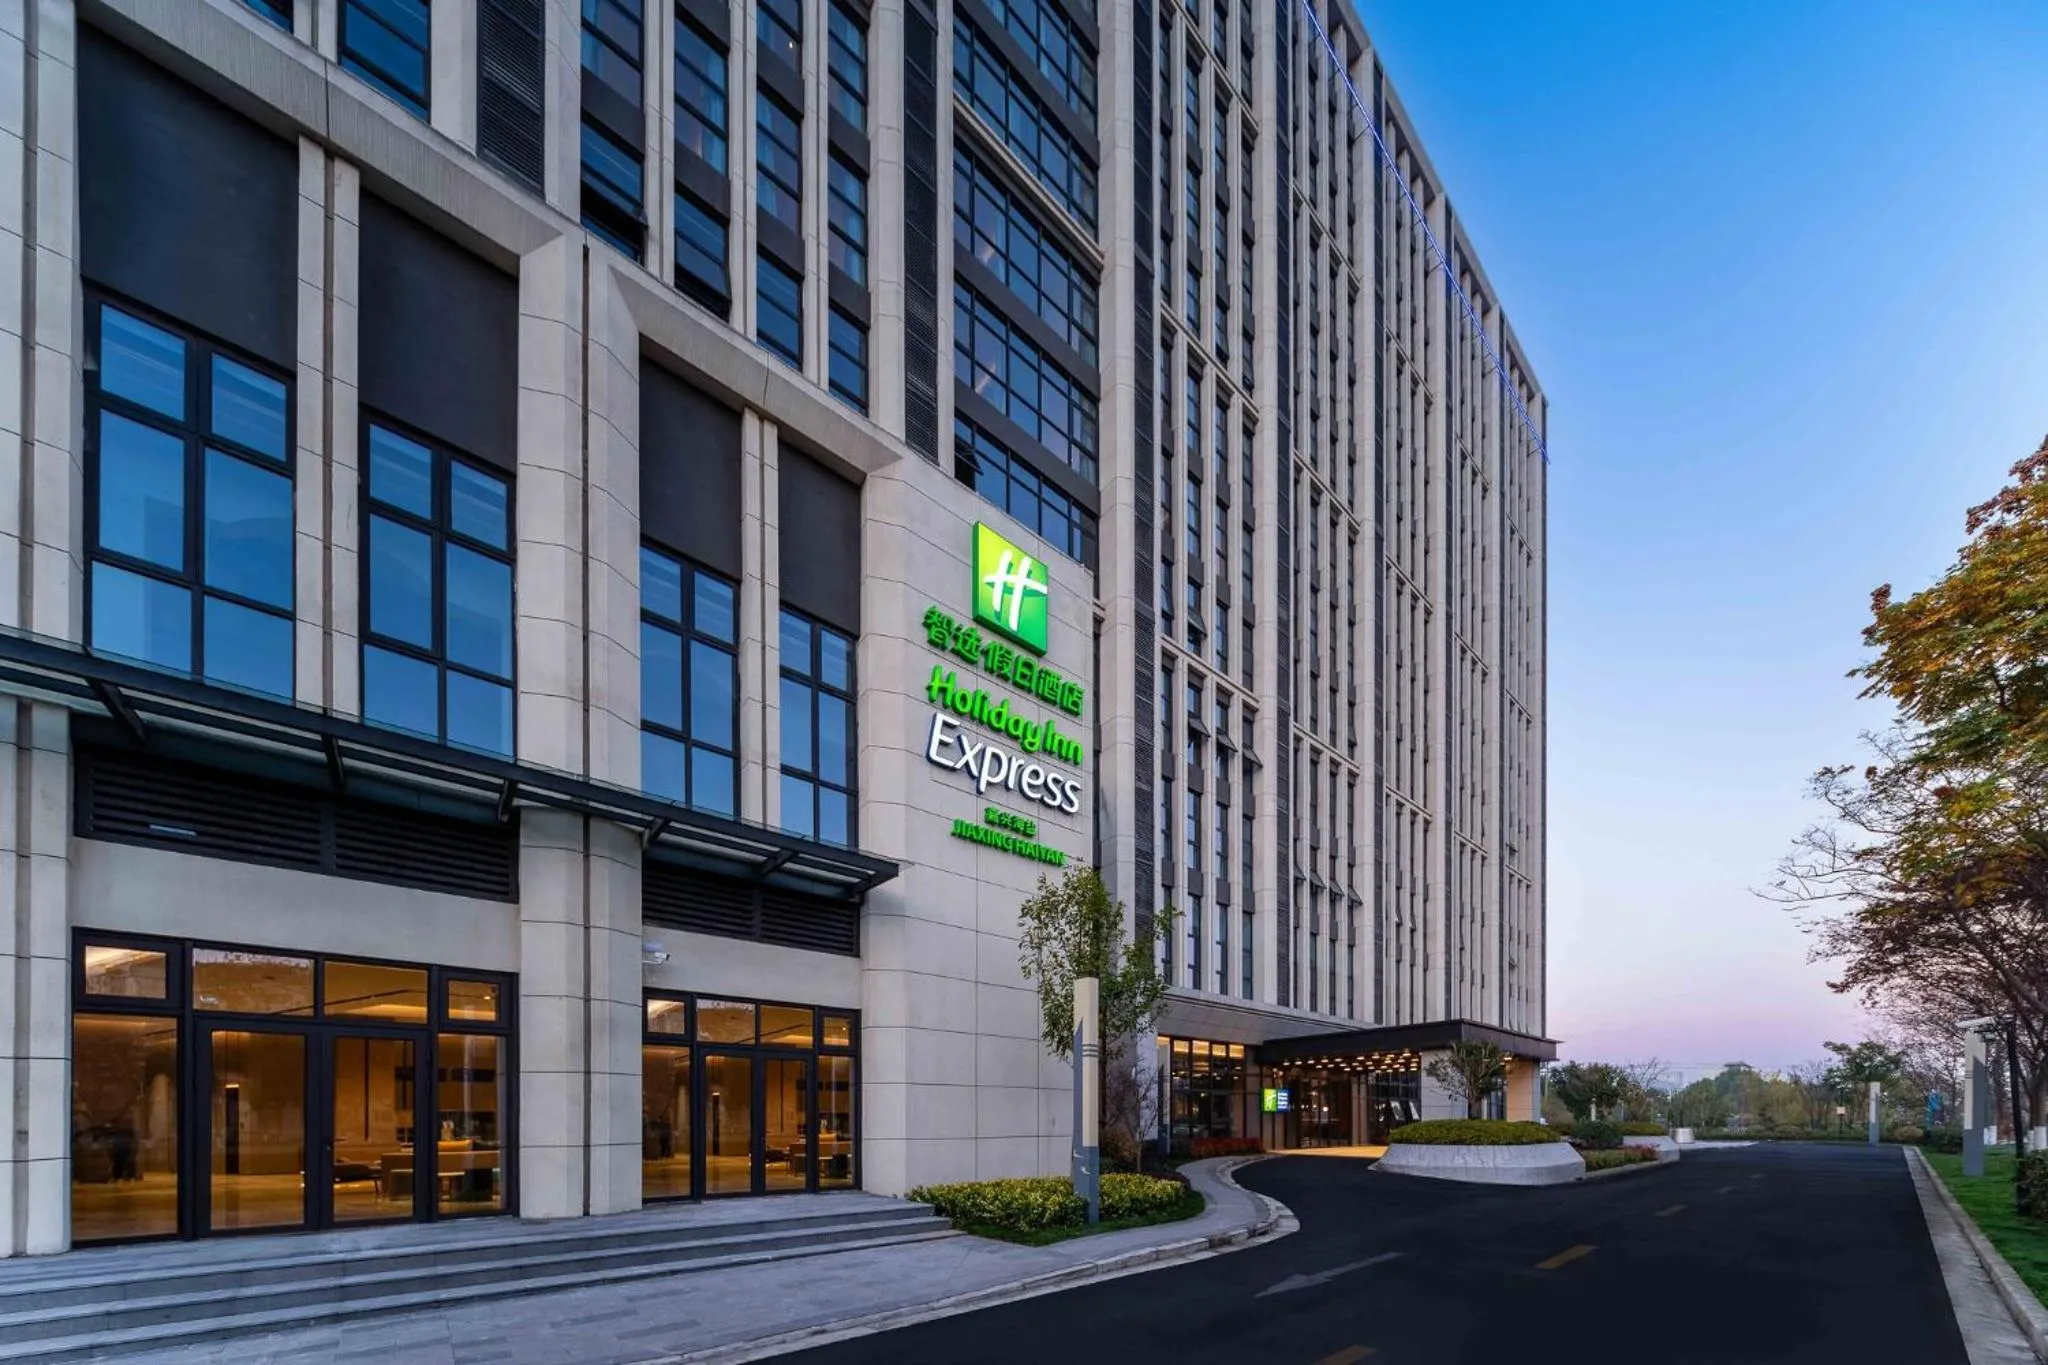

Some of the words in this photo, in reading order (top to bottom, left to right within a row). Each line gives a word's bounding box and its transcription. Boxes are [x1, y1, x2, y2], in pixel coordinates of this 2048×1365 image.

[922, 605, 1085, 717] 智选假日酒店
[927, 664, 1042, 753] Holiday
[1042, 720, 1083, 765] Inn
[927, 712, 1082, 815] Express
[951, 819, 1013, 851] JIAXING
[1013, 838, 1066, 867] HAIYAN
